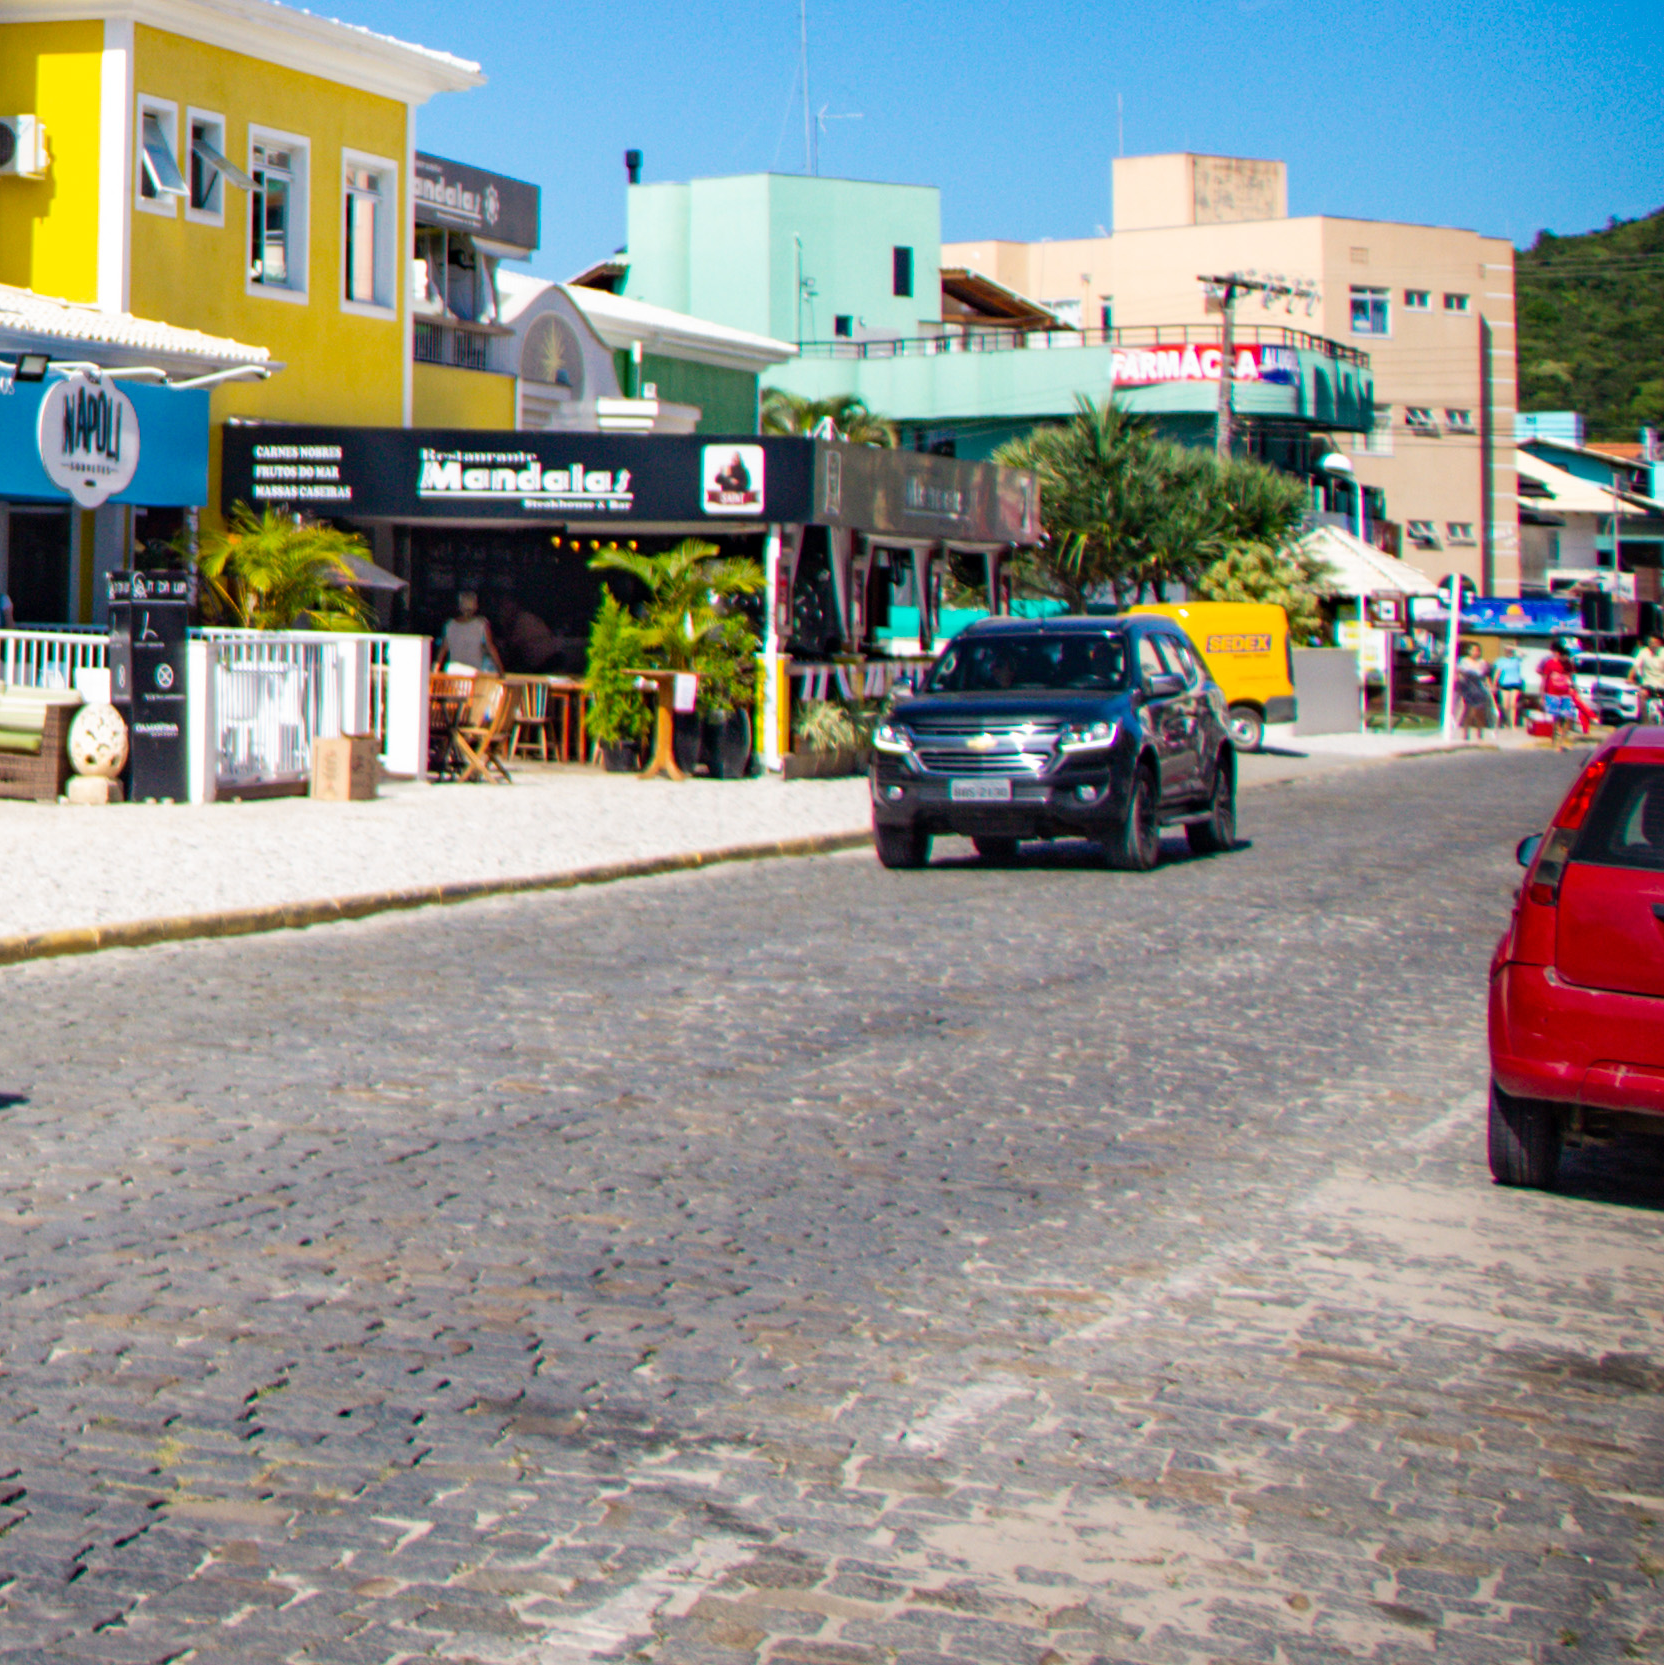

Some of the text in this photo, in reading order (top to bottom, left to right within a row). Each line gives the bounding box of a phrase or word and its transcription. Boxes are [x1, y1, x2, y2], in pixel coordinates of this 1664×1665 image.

[1111, 344, 1259, 380] FARMÁCA
[62, 385, 122, 463] NAPOLI
[253, 444, 343, 460] CARNES NOBRES
[420, 448, 538, 463] Restaurante
[253, 464, 340, 480] FRUTOS DO MAR
[418, 459, 632, 493] Mandalas
[253, 484, 353, 500] MASSAS CASEIRAS
[608, 499, 633, 511] Bar
[1210, 636, 1270, 652] SEDEX
